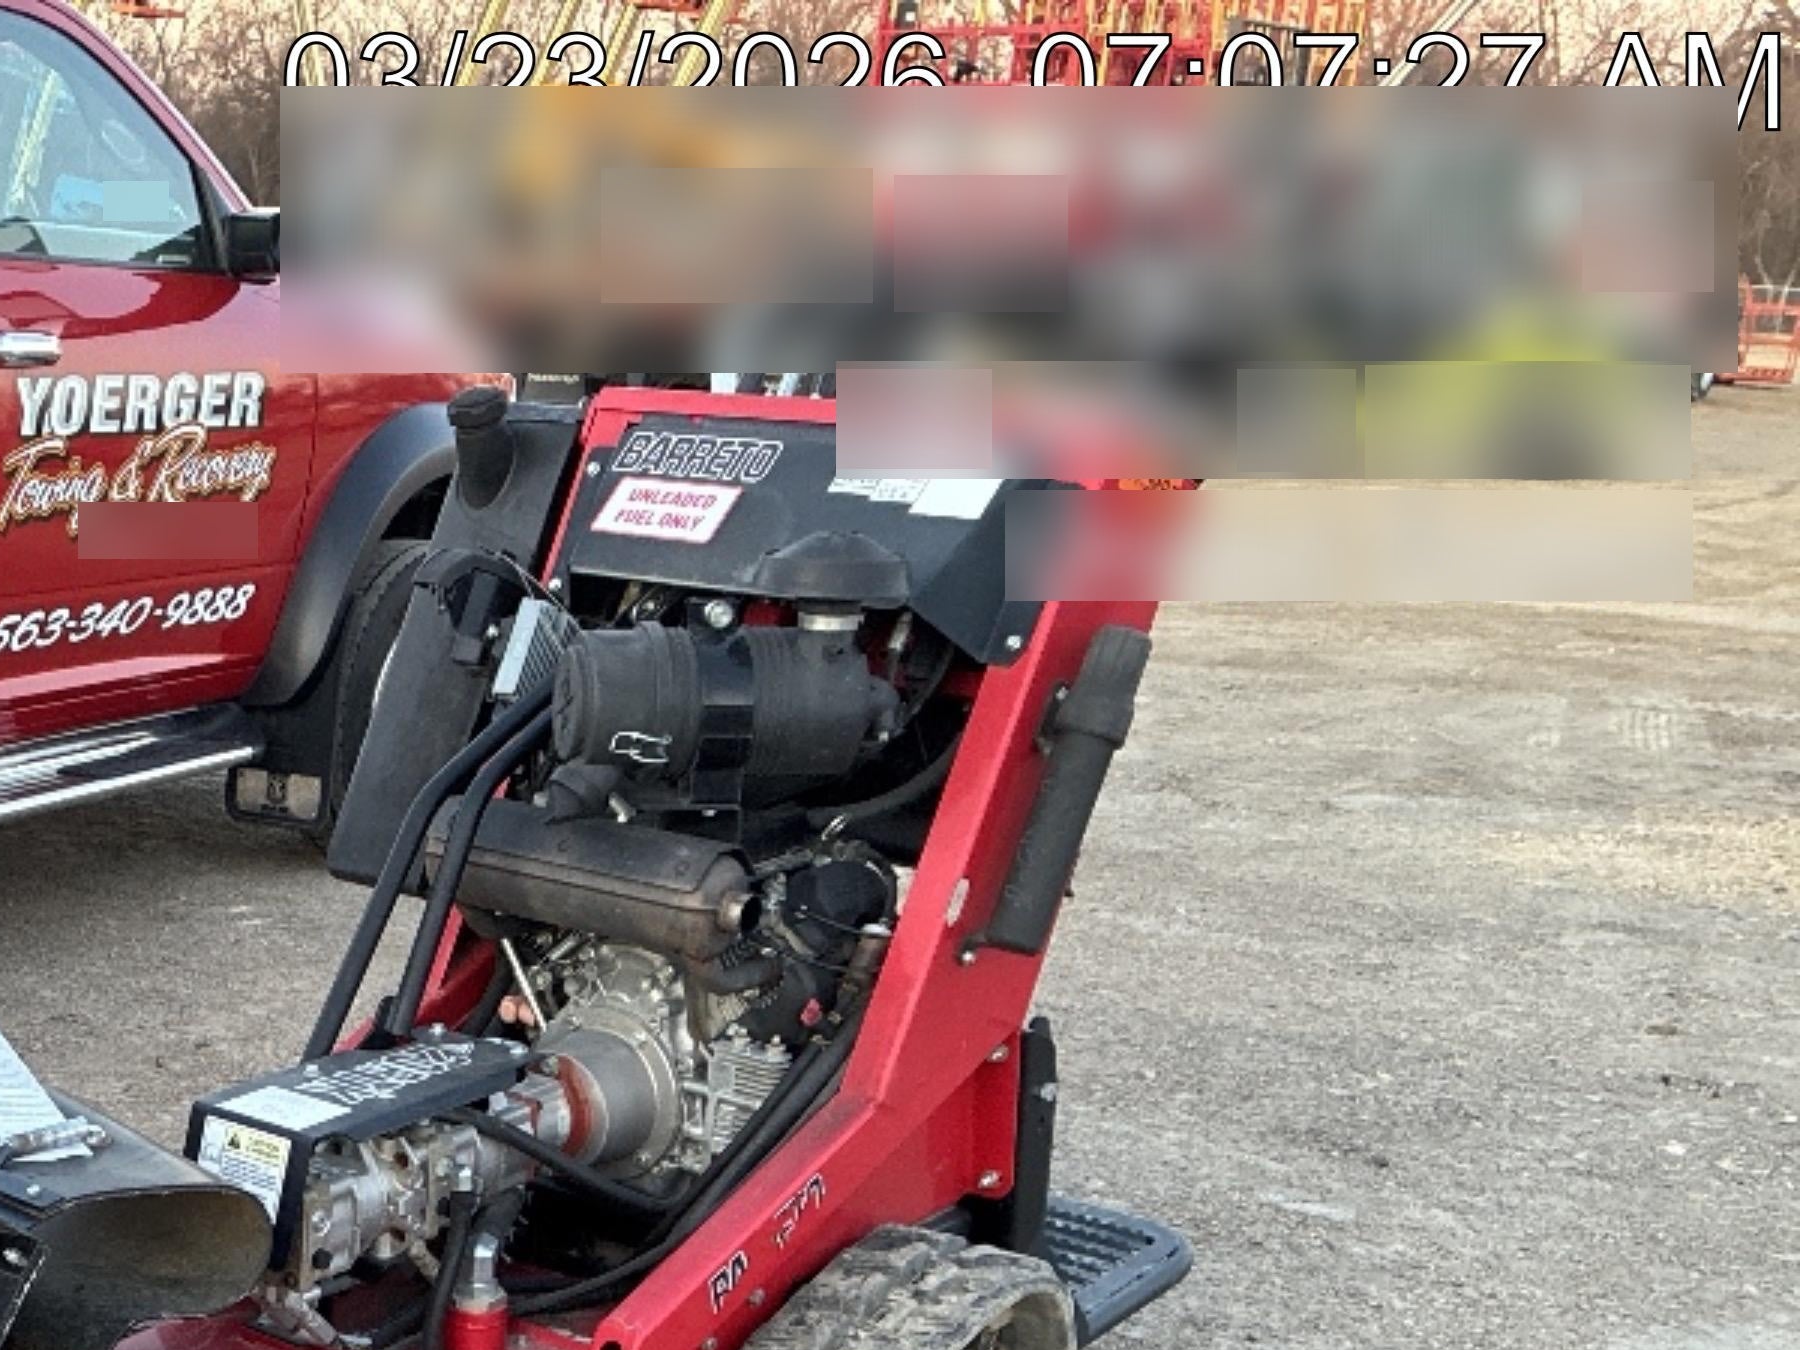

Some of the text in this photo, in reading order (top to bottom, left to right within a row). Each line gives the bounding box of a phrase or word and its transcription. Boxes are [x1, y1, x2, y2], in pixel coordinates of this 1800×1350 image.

[16, 371, 266, 437] YOERGER
[109, 435, 153, 502] &
[611, 431, 784, 484] BARRETO
[614, 508, 706, 532] FUEL ONLY
[628, 488, 718, 511] UNLEADED
